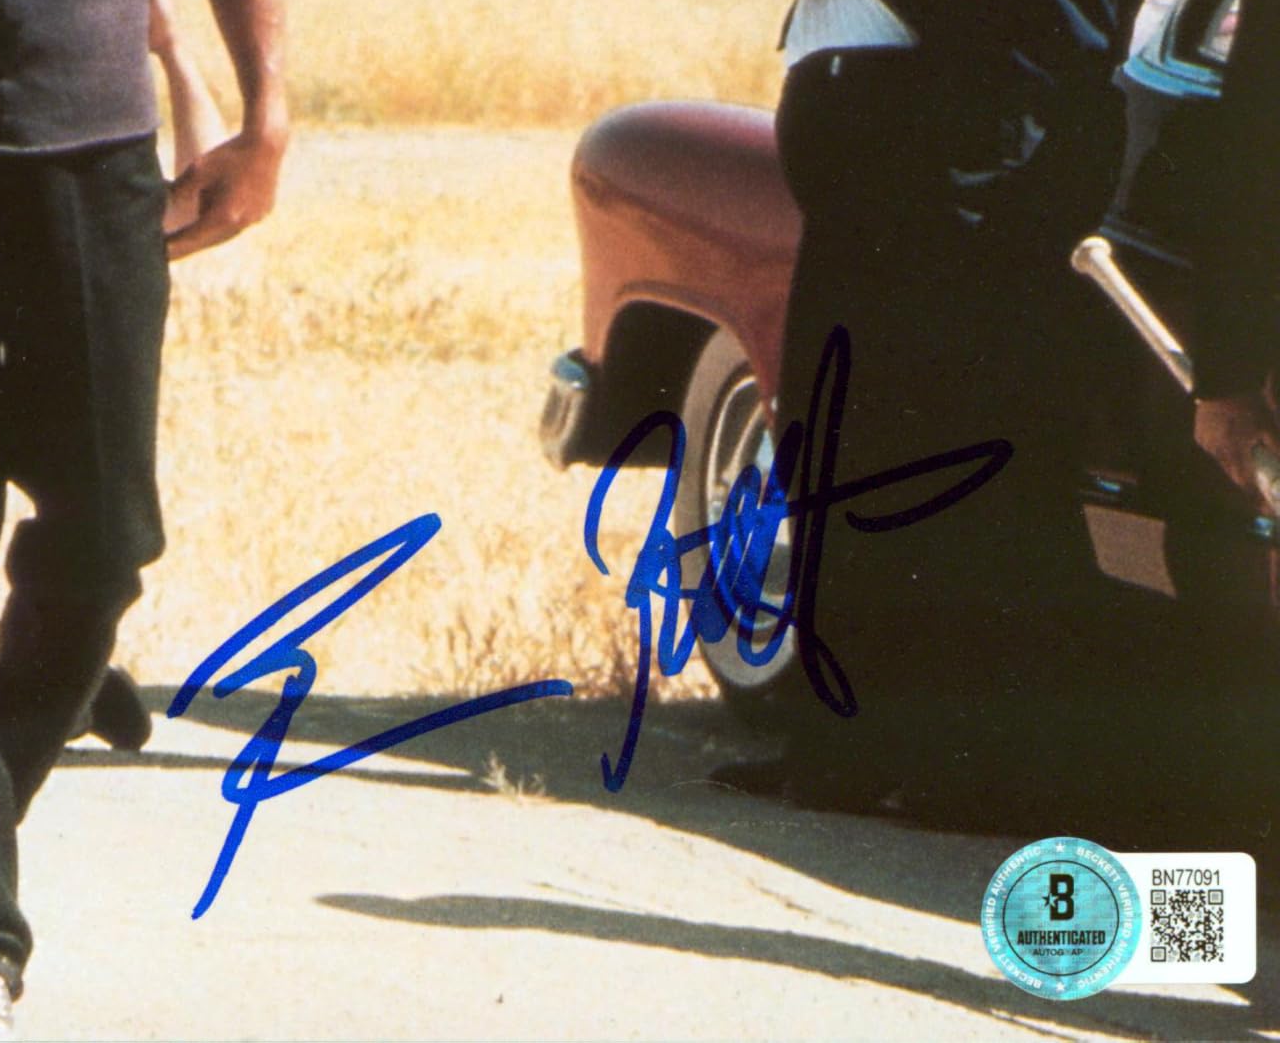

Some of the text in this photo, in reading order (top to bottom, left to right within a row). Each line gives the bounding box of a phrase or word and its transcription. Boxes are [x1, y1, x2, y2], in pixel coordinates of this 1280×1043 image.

[990, 846, 1042, 897] AUTHENTIC
[1076, 846, 1121, 882] BECKETT
[1151, 869, 1221, 887] BN77091
[1017, 930, 1106, 945] AUTHENTICATED
[1032, 948, 1091, 956] AUTOGAP
[999, 953, 1043, 989] BECKETT
